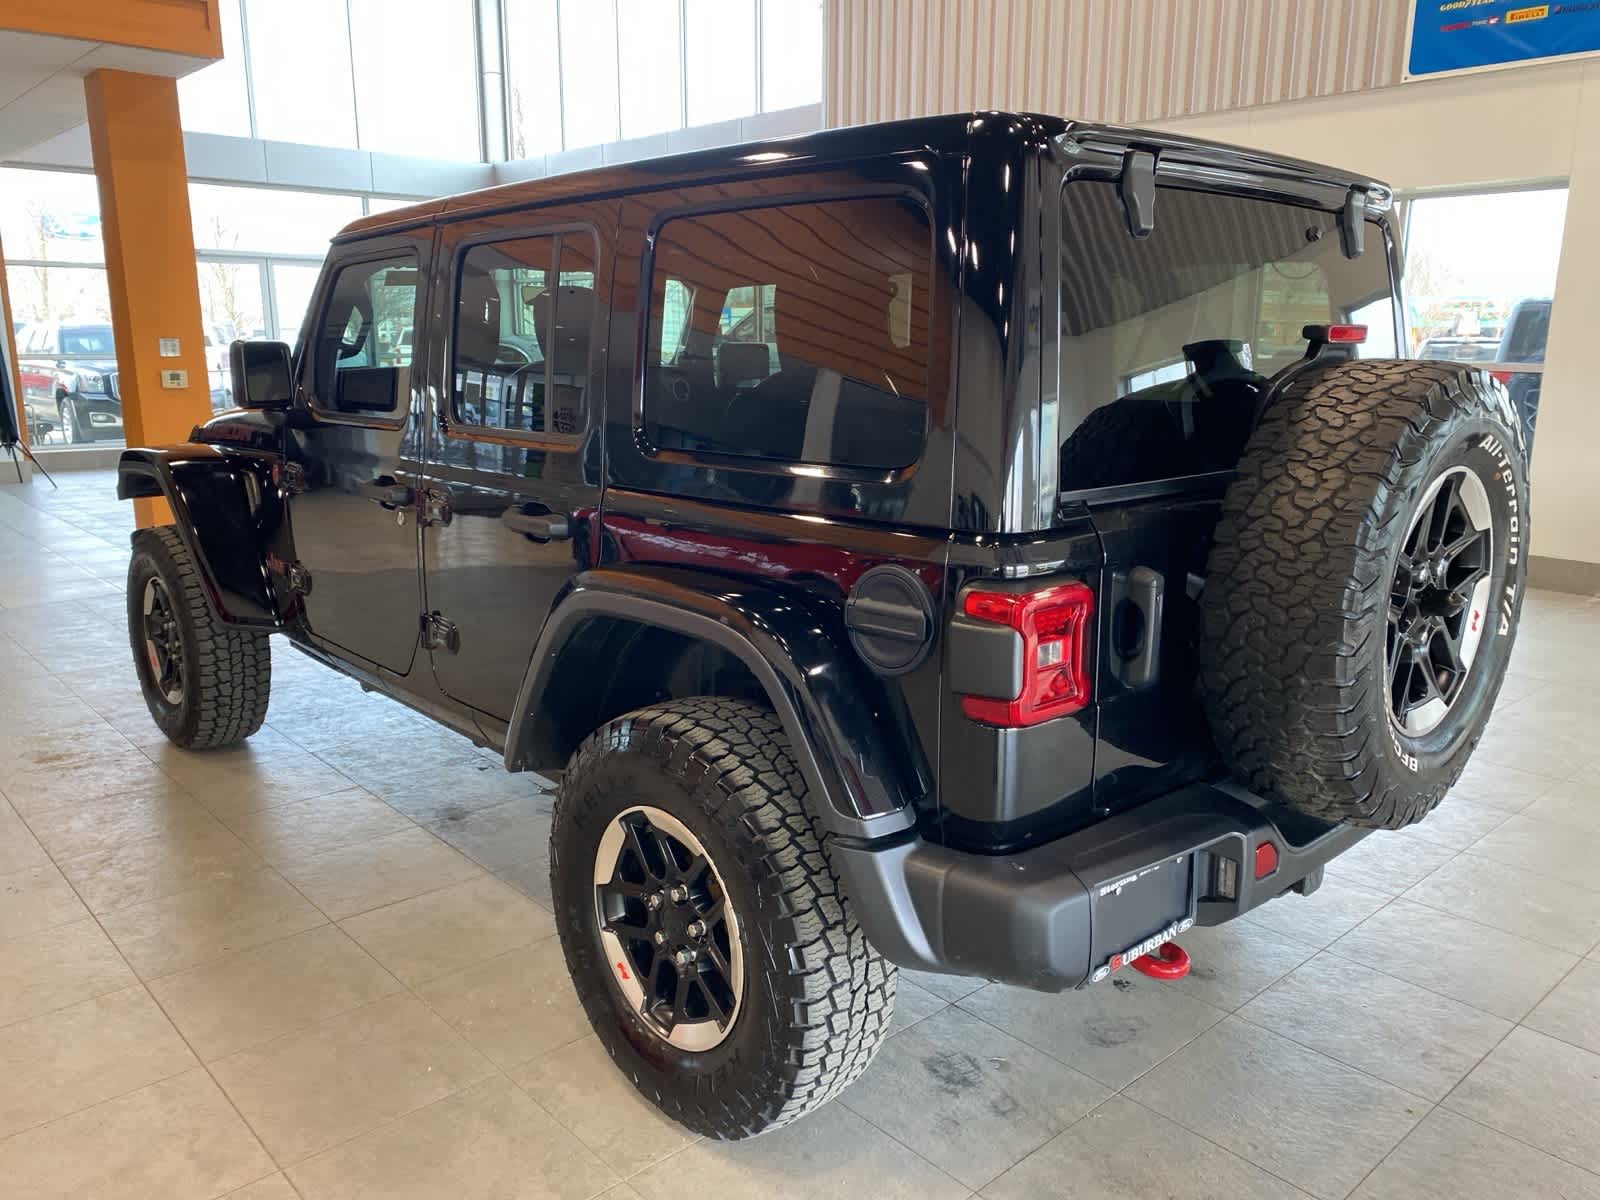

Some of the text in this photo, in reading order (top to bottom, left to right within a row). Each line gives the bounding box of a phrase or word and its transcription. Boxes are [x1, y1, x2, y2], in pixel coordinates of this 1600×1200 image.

[1510, 8, 1545, 21] PIRELLI
[1478, 434, 1521, 636] All-Terrain T/A
